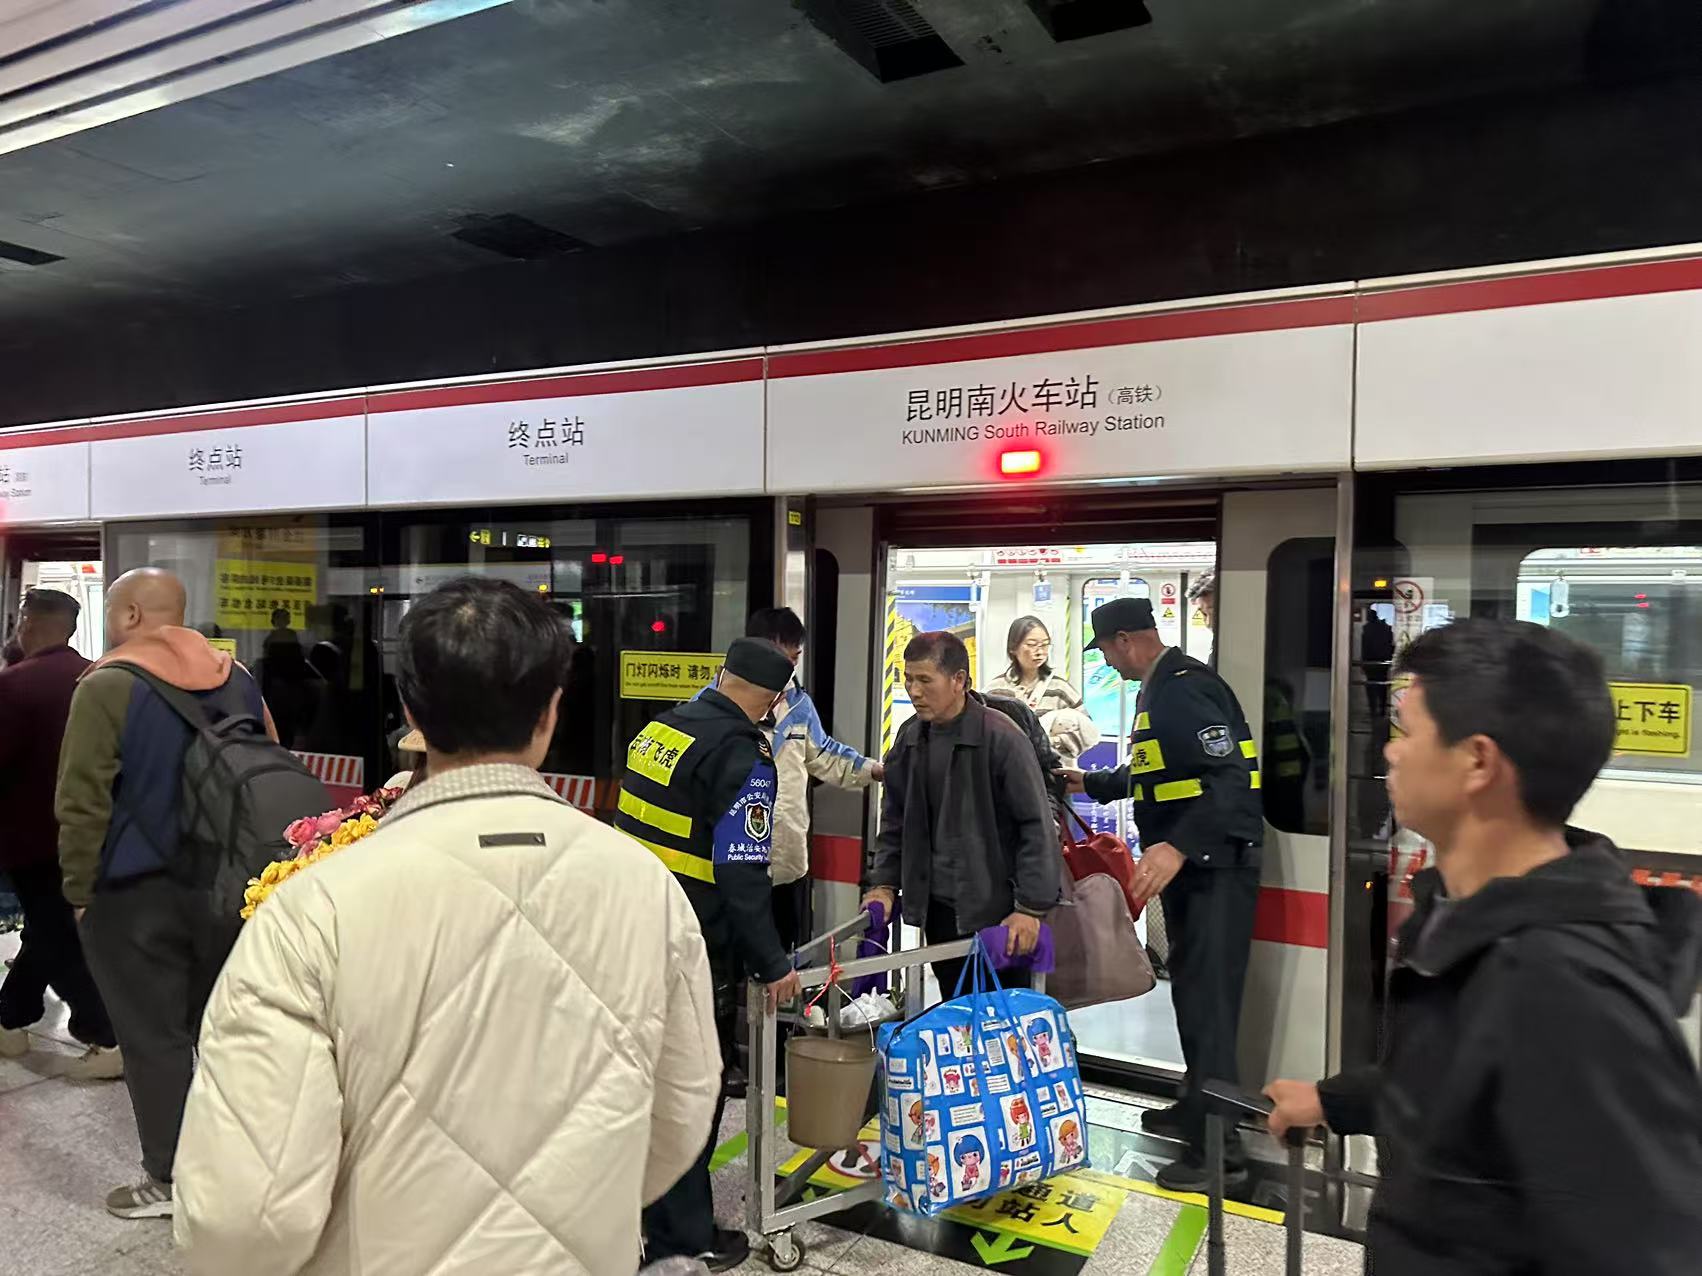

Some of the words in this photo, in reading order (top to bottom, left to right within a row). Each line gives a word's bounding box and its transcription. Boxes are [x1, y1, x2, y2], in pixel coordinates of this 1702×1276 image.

[906, 374, 1100, 422] 昆明南火车站
[508, 416, 585, 449] 终点站
[902, 425, 980, 446] KUNMING
[984, 422, 1030, 440] South
[1034, 418, 1100, 437] Railway
[1104, 413, 1165, 432] Station
[188, 443, 243, 471] 终点站
[523, 451, 570, 467] Terminal
[625, 662, 681, 680] 门灯闪烁时
[1615, 699, 1681, 724] 上下车
[727, 853, 744, 861] Public
